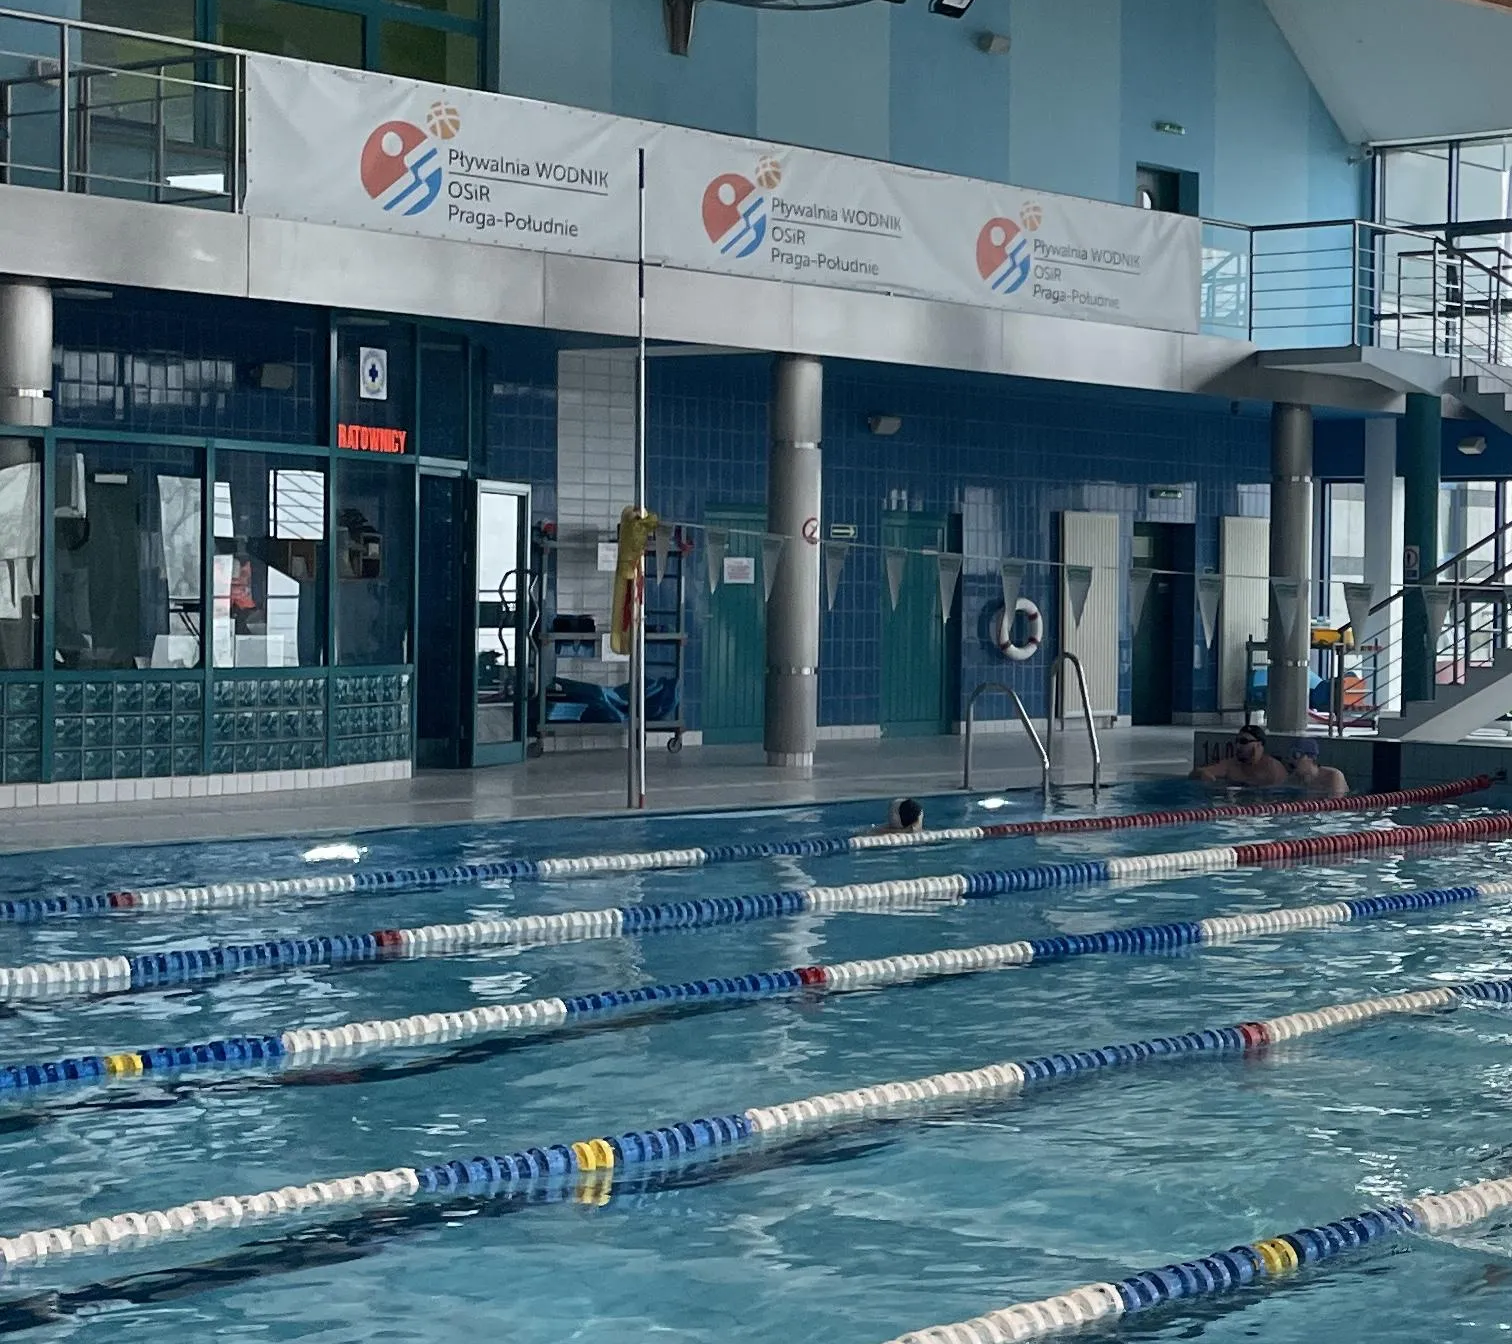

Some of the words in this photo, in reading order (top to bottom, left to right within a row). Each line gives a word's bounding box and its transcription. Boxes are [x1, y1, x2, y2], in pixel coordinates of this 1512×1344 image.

[448, 148, 530, 176] Pływalnia
[535, 161, 609, 189] WODNIK
[448, 181, 490, 202] OSiR
[448, 204, 578, 237] Praga-Południe
[771, 197, 838, 221] Pływalnia
[841, 207, 902, 231] WODNIK
[771, 226, 806, 245] OSiR
[771, 247, 879, 275] Praga-Południe
[1090, 248, 1141, 268] WODNIK
